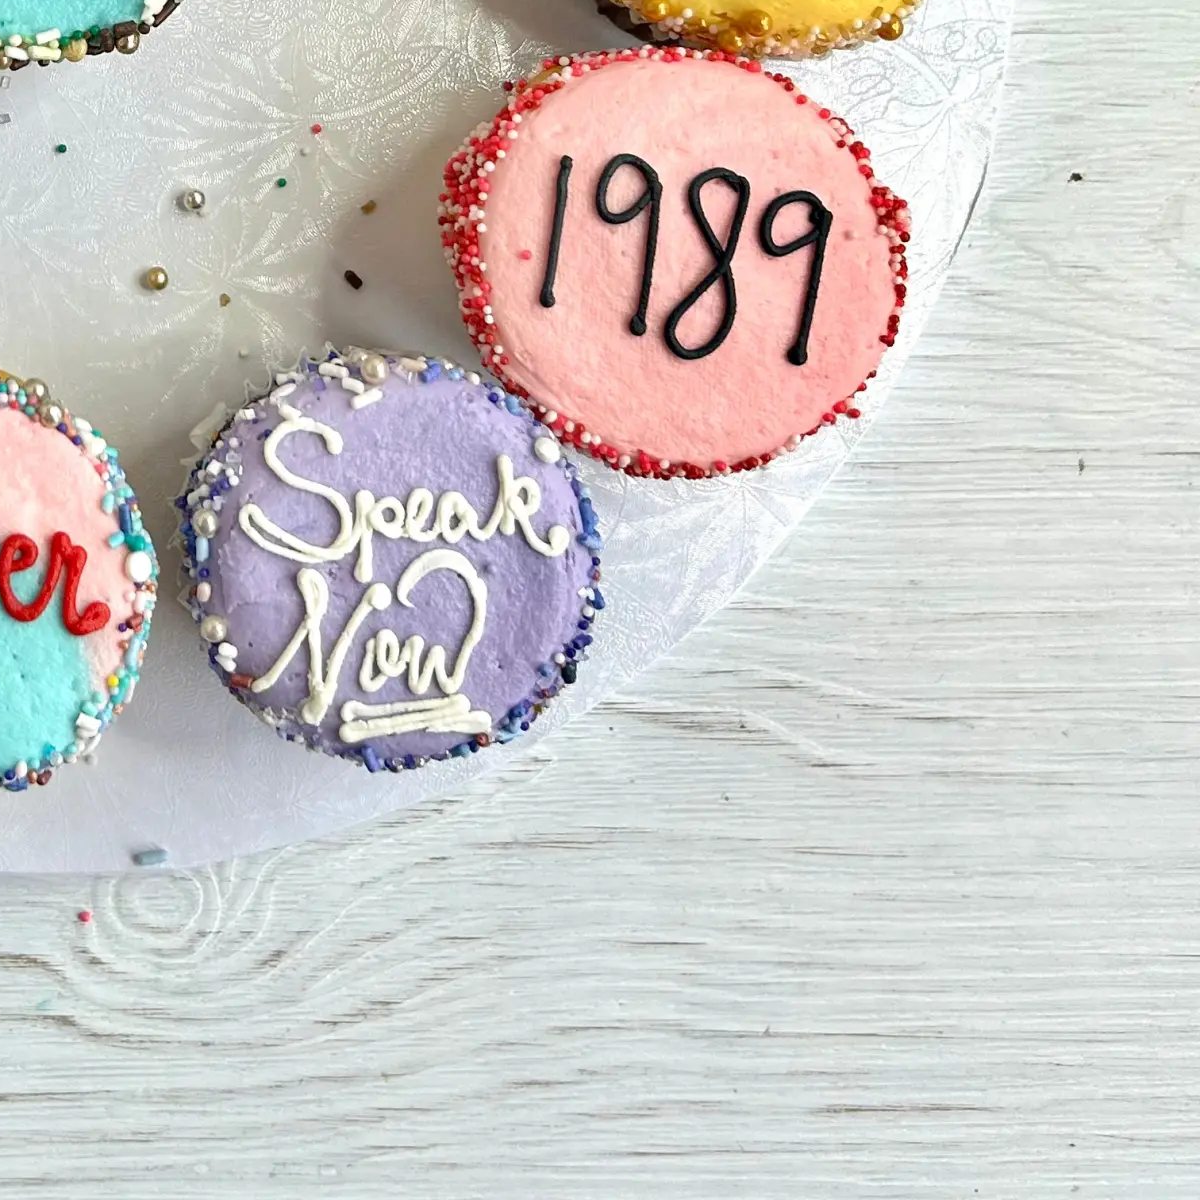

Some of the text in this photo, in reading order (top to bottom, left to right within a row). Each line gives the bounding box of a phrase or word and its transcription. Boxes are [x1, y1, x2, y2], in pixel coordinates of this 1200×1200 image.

[539, 153, 834, 367] 1989
[239, 404, 569, 583] Speak
[251, 550, 487, 723] Now
